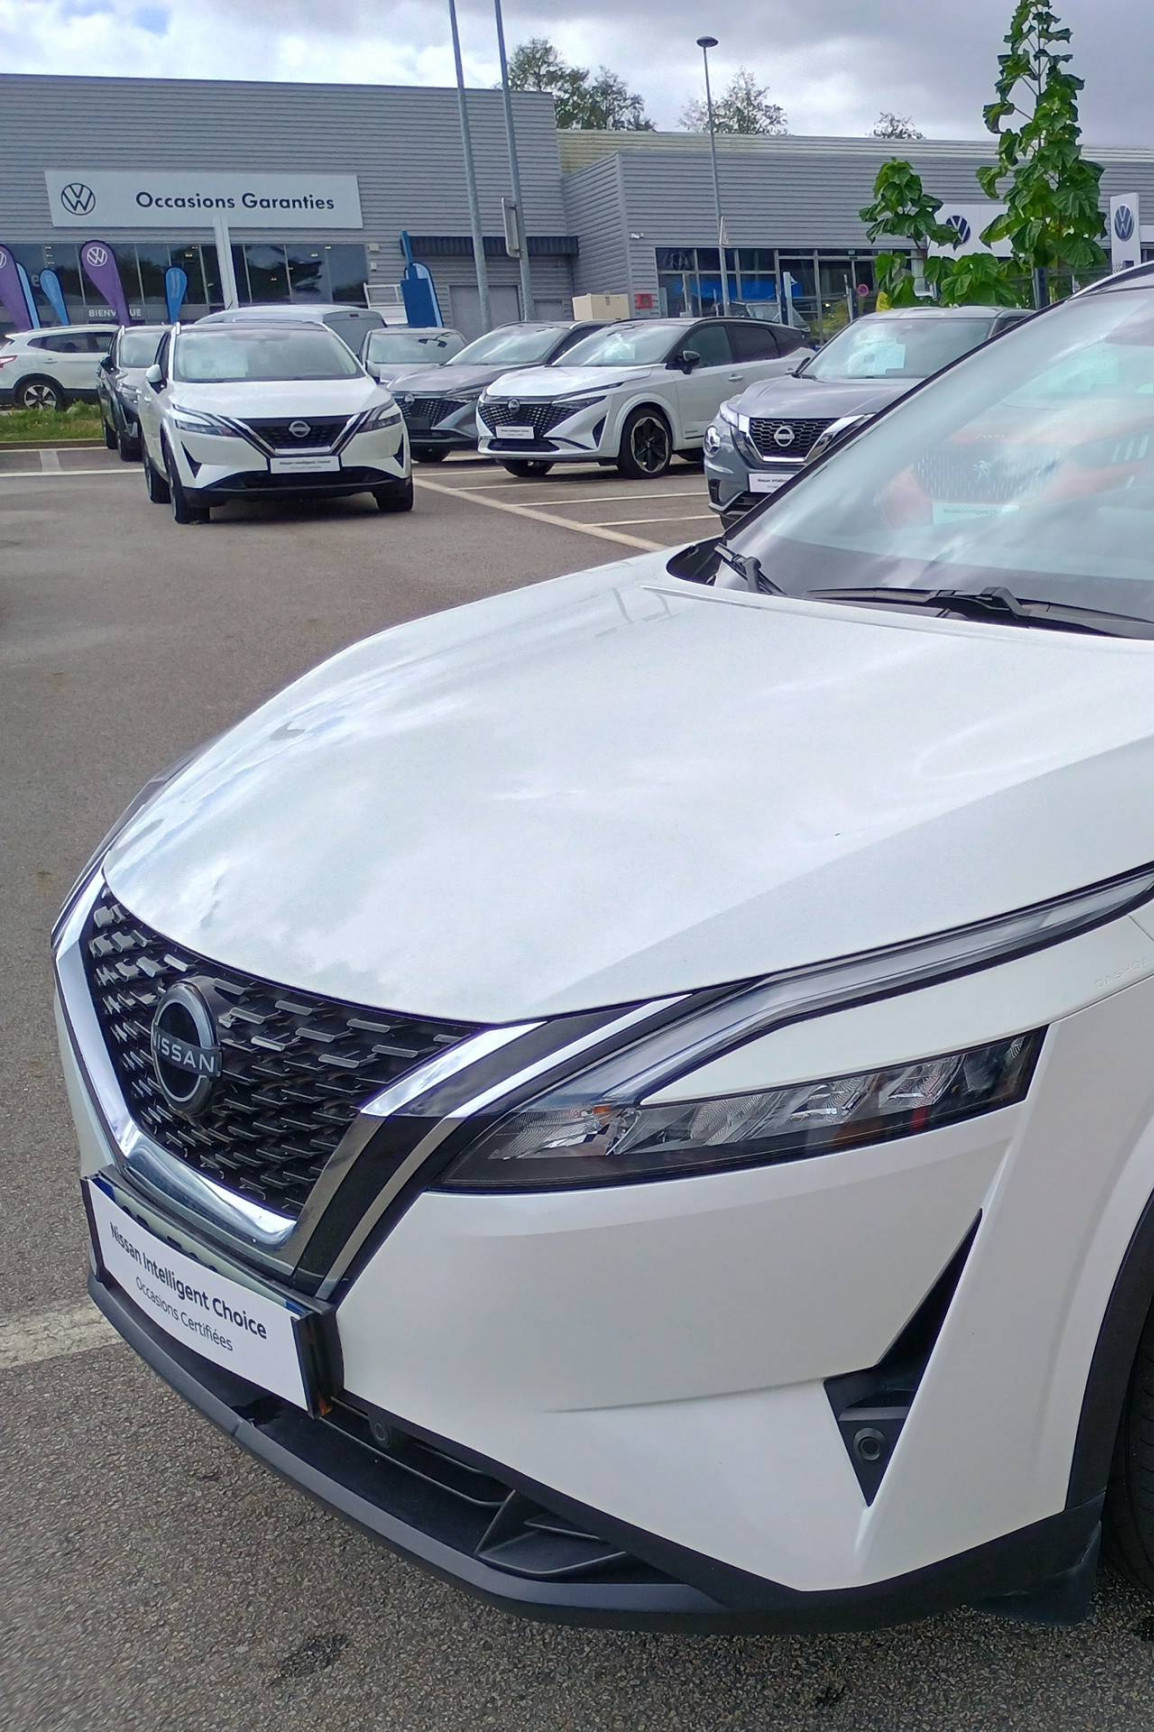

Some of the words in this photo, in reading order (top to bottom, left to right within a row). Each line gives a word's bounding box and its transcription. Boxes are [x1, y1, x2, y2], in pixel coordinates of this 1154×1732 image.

[136, 191, 236, 209] Occasions
[241, 192, 335, 210] Garanties
[88, 308, 142, 318] BIENVUE
[109, 1221, 142, 1263] Nissan
[142, 1252, 210, 1311] Intelligent
[212, 1297, 267, 1340] Choice
[135, 1276, 179, 1322] Occasions
[180, 1312, 234, 1352] Certifiées
